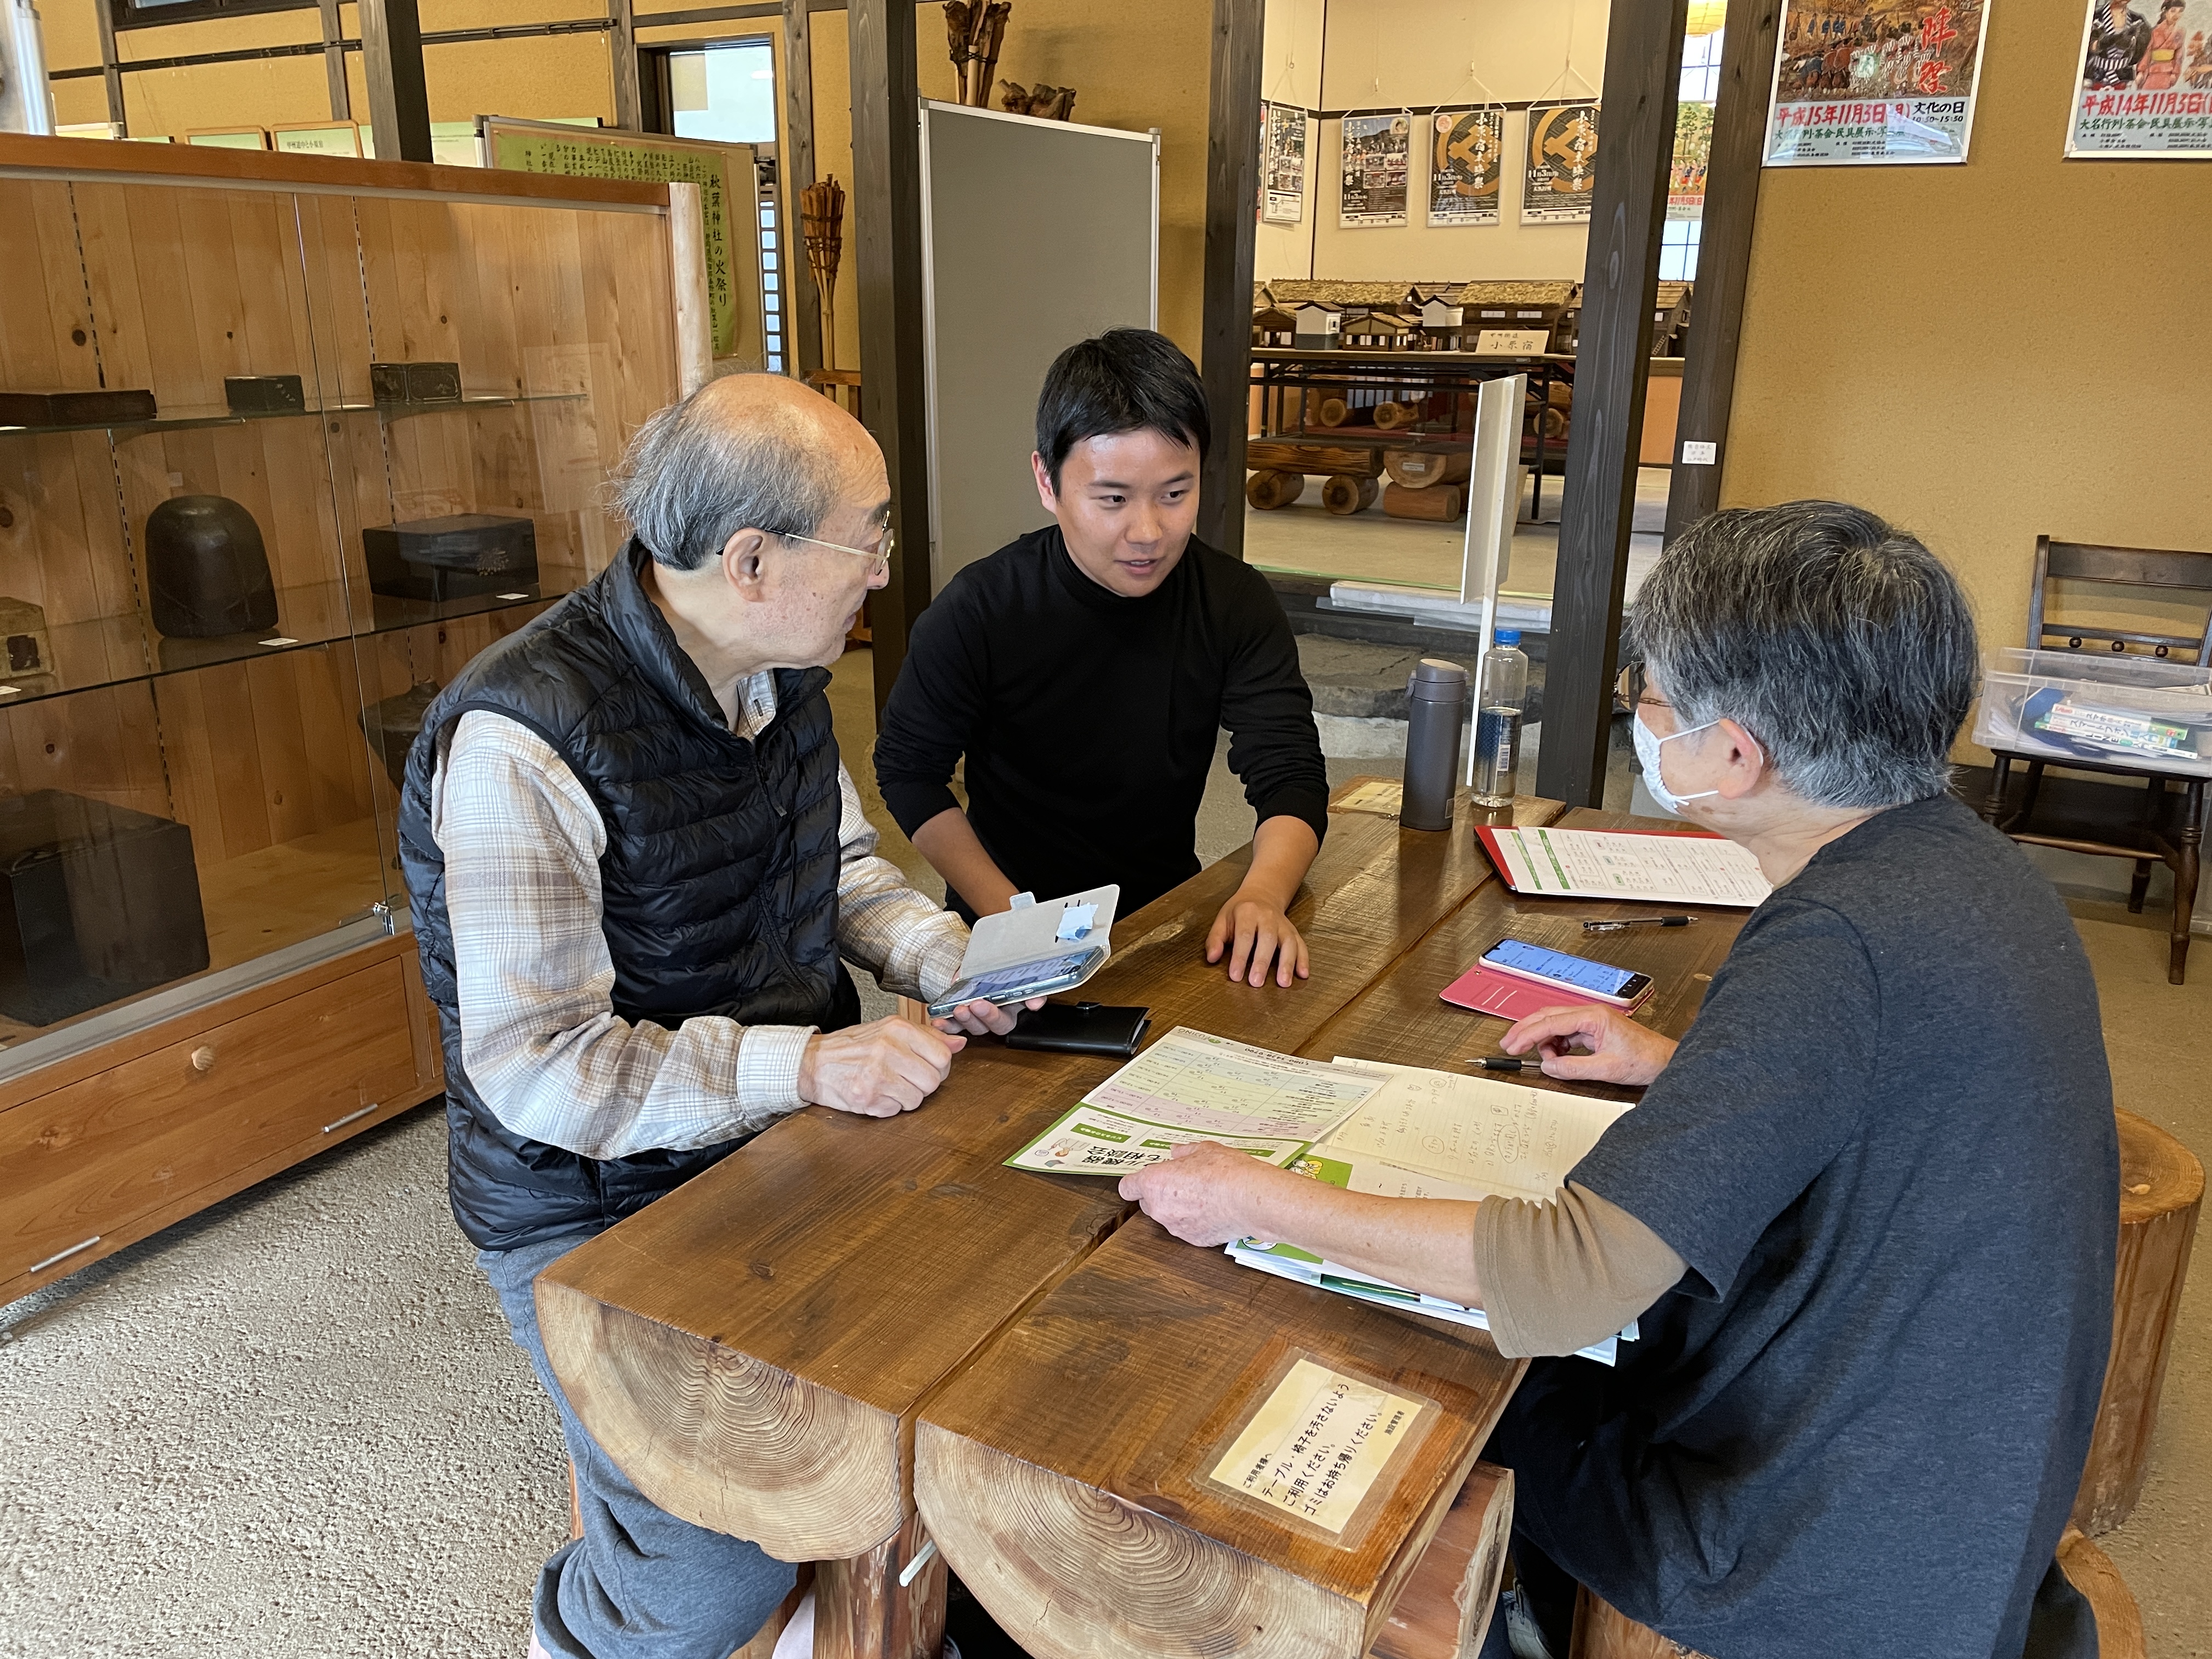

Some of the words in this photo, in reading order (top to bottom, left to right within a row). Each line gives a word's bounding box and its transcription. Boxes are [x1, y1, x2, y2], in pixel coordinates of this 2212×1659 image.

[1776, 103, 1910, 127] 平成15年11月3日月)
[1912, 101, 1965, 115] 文化の日
[2082, 92, 2212, 116] 平成14年11月3日(
[1474, 112, 1488, 189] 小原宿本陣祭
[1572, 110, 1589, 191] 小原宿本陣祭
[709, 174, 727, 307] 秋葉神社の火祭り
[1491, 340, 1534, 351] 小原宿
[1081, 1155, 1151, 1166] ル機器
[1087, 1146, 1170, 1161] も相談会
[1261, 1383, 1350, 1498] テーブル・椅子を汚さないよう
[1243, 1452, 1273, 1489] ご利用者様へ
[1283, 1443, 1336, 1508] ご利用ください。
[1304, 1410, 1383, 1516] ゴミはお持ち帰りください。
